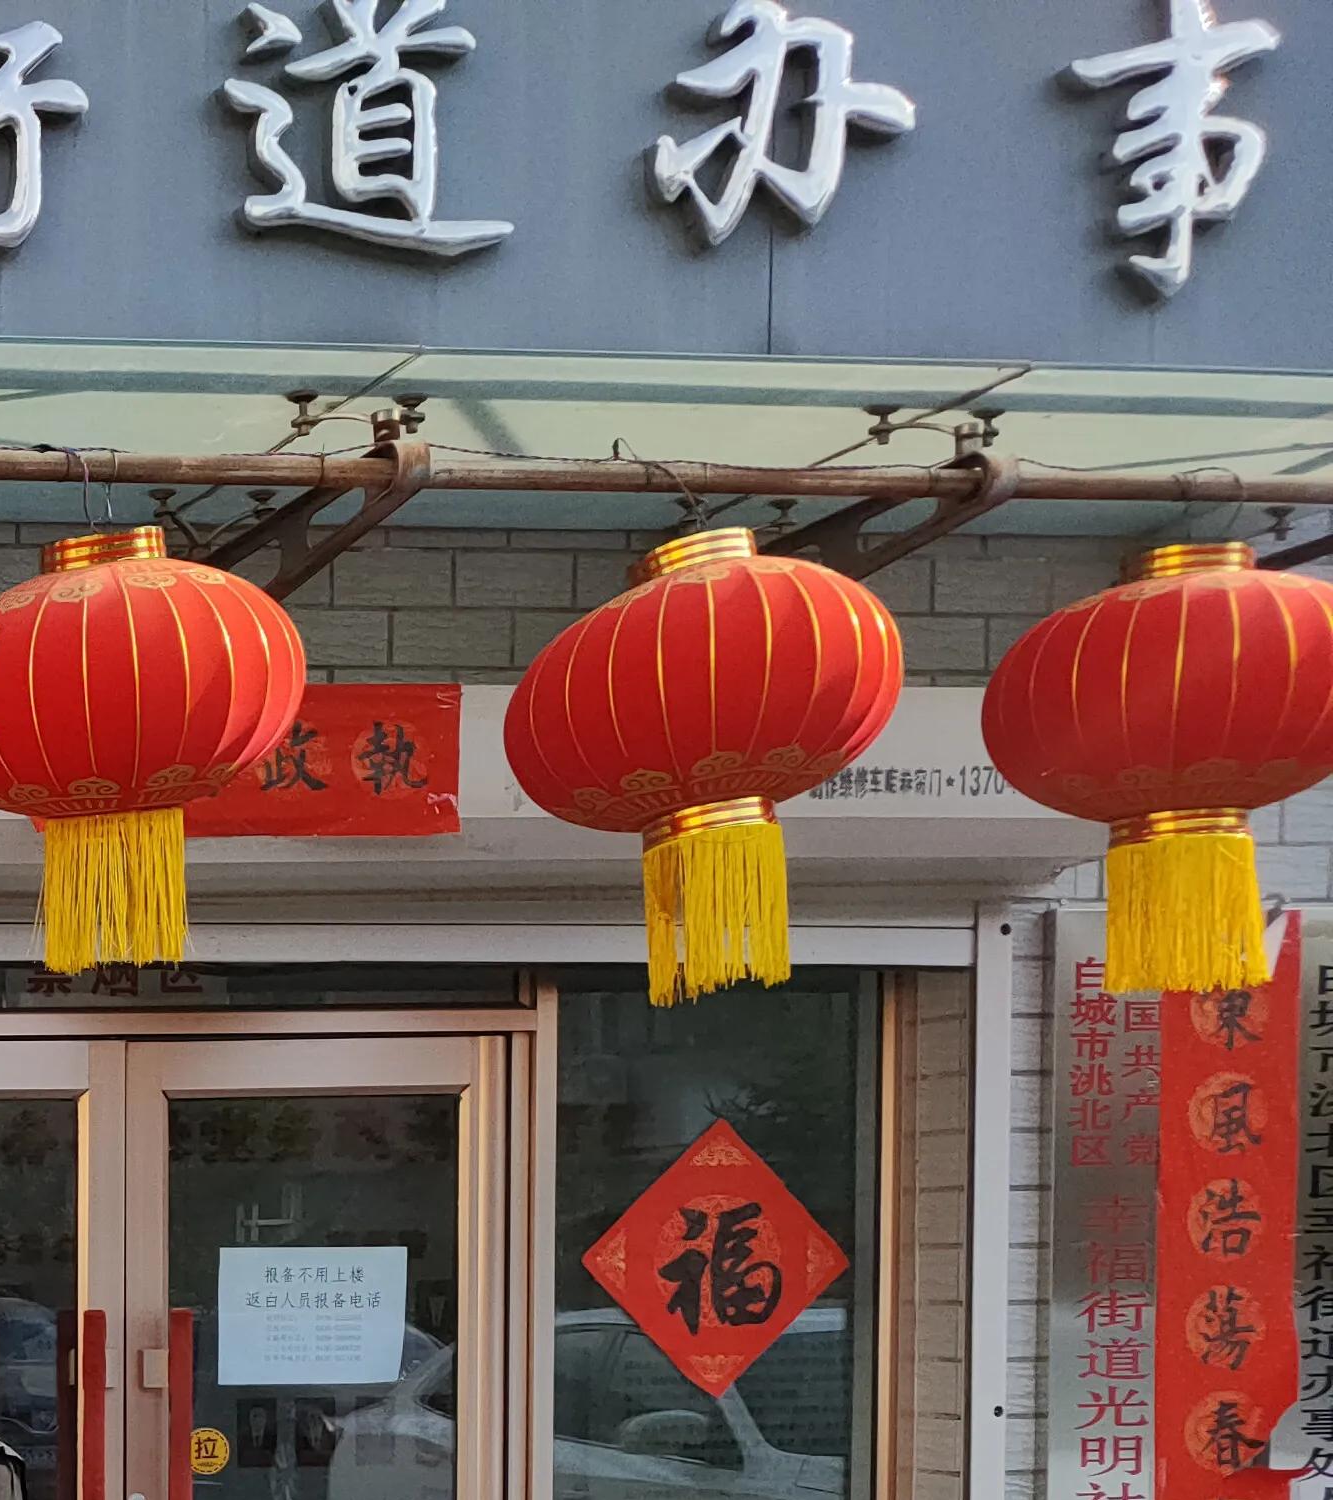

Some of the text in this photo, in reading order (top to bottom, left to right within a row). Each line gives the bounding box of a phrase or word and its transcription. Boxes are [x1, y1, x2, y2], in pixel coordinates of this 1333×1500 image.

[1120, 998, 1161, 1166] 国共产党
[264, 1266, 365, 1284] 报备不用上楼
[658, 1202, 782, 1336] 福
[245, 1291, 382, 1310] 返白人员报备电话
[194, 1437, 219, 1460] 拉
